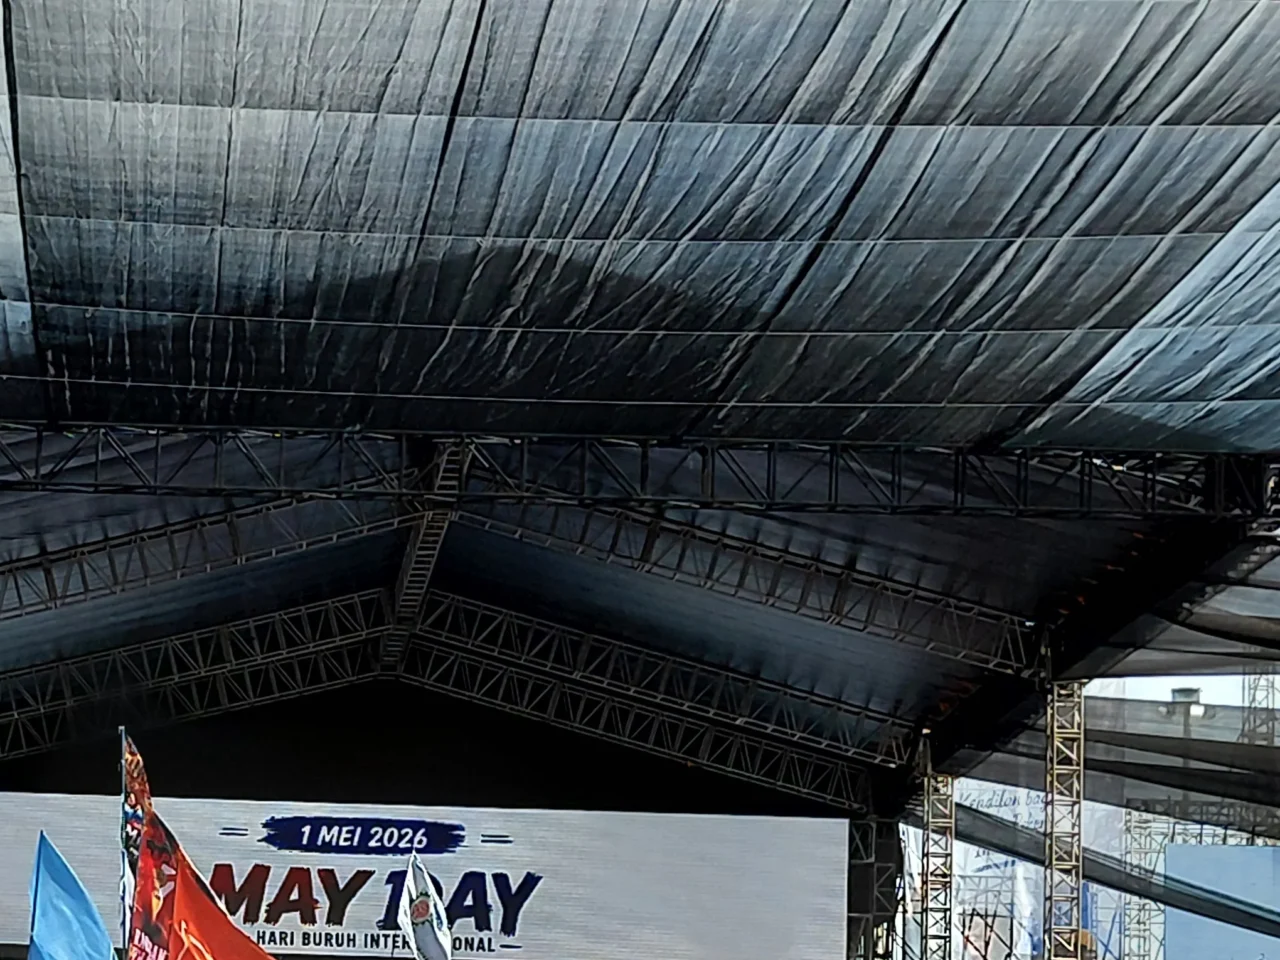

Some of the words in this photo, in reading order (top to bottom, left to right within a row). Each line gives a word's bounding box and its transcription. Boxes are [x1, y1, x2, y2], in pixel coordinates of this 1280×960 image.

[300, 825, 310, 845] 1
[317, 826, 361, 847] MEI
[368, 828, 428, 849] 2026
[209, 863, 377, 927] MAY
[256, 930, 294, 947] HARI
[302, 932, 357, 948] BURUH
